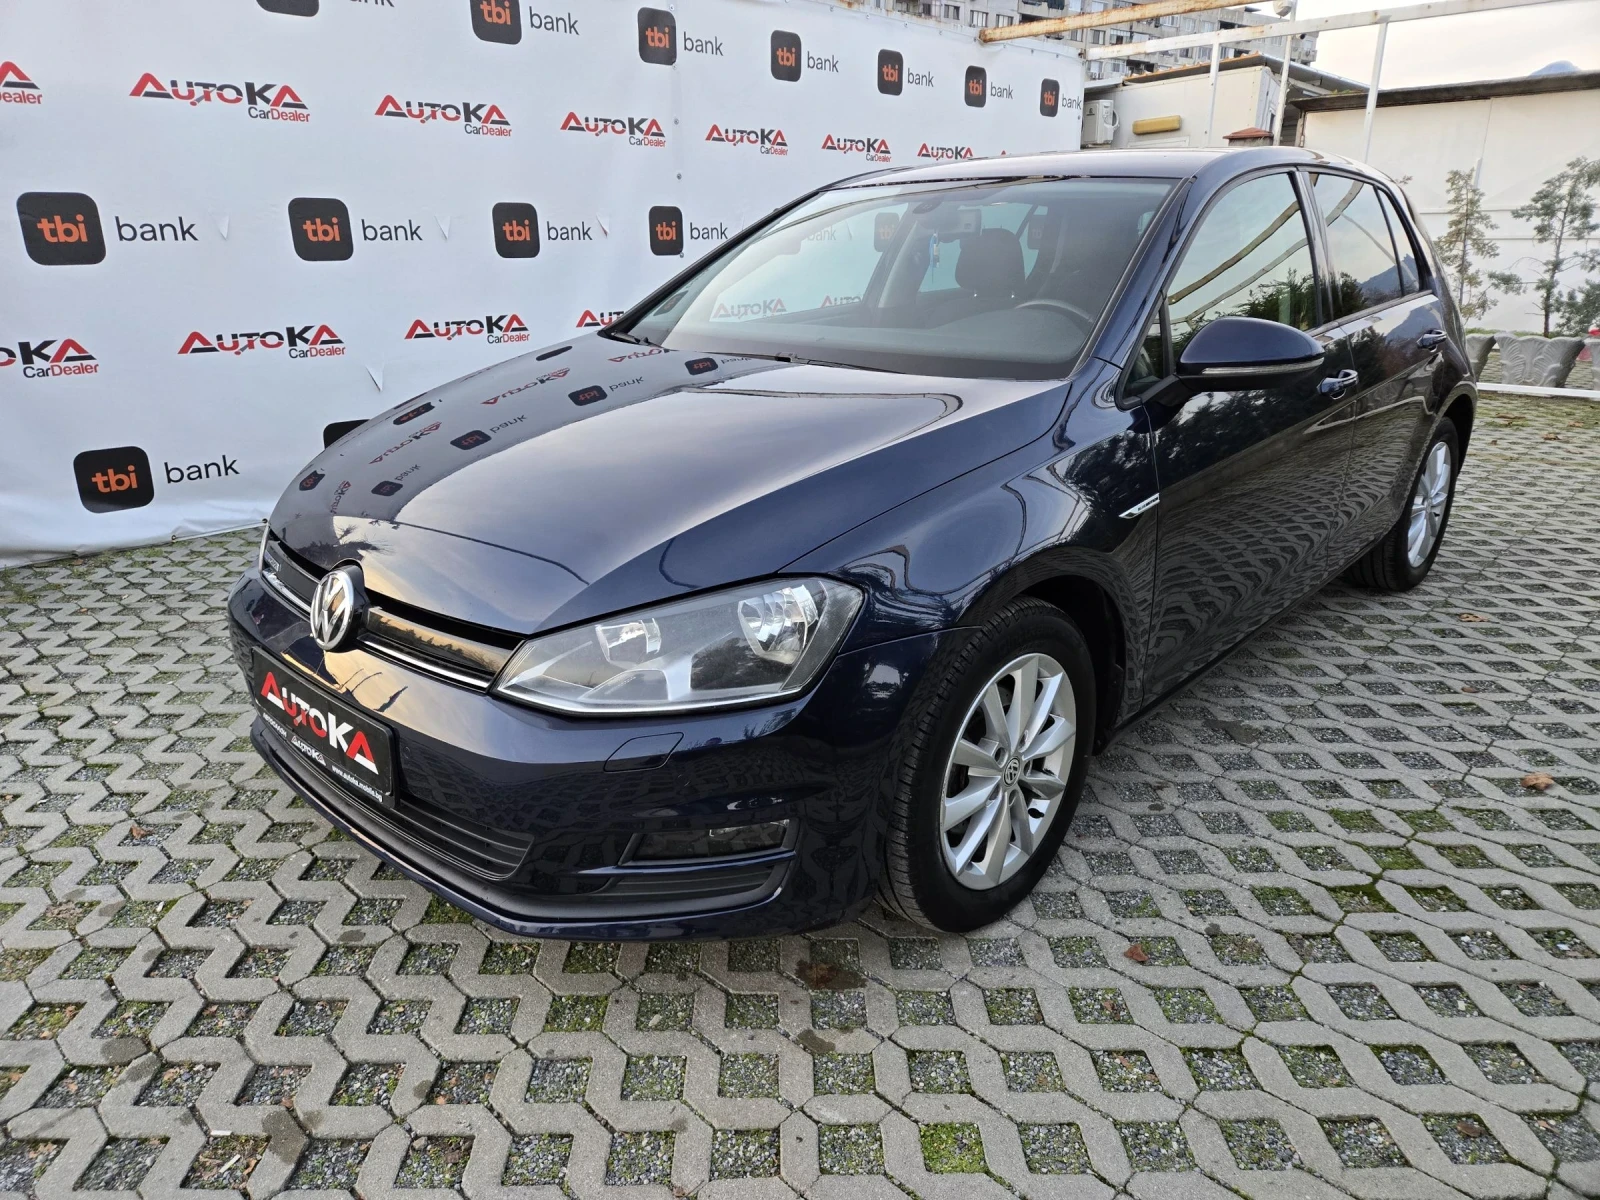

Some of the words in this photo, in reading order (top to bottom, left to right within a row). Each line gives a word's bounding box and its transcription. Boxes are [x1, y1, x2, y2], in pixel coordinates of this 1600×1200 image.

[480, 0, 512, 25] tbi
[529, 6, 579, 35] bank
[645, 26, 670, 48] tbi
[683, 31, 724, 56] bank
[776, 47, 796, 66] tbi
[807, 51, 839, 73] bank
[882, 65, 898, 82] tbi
[907, 68, 934, 87] bank
[0, 90, 42, 104] ealer
[969, 79, 983, 96] tbi
[990, 82, 1013, 99] bank
[1044, 90, 1056, 106] tbi
[1061, 94, 1081, 110] bank
[37, 214, 88, 243] tbi
[115, 216, 199, 242] bank
[302, 217, 340, 242] tbi
[361, 219, 423, 241] bank
[503, 219, 530, 241] tbi
[547, 221, 593, 241] bank
[655, 221, 676, 240] tbi
[690, 222, 728, 240] bank
[92, 464, 138, 493] tbi
[163, 454, 240, 484] bank
